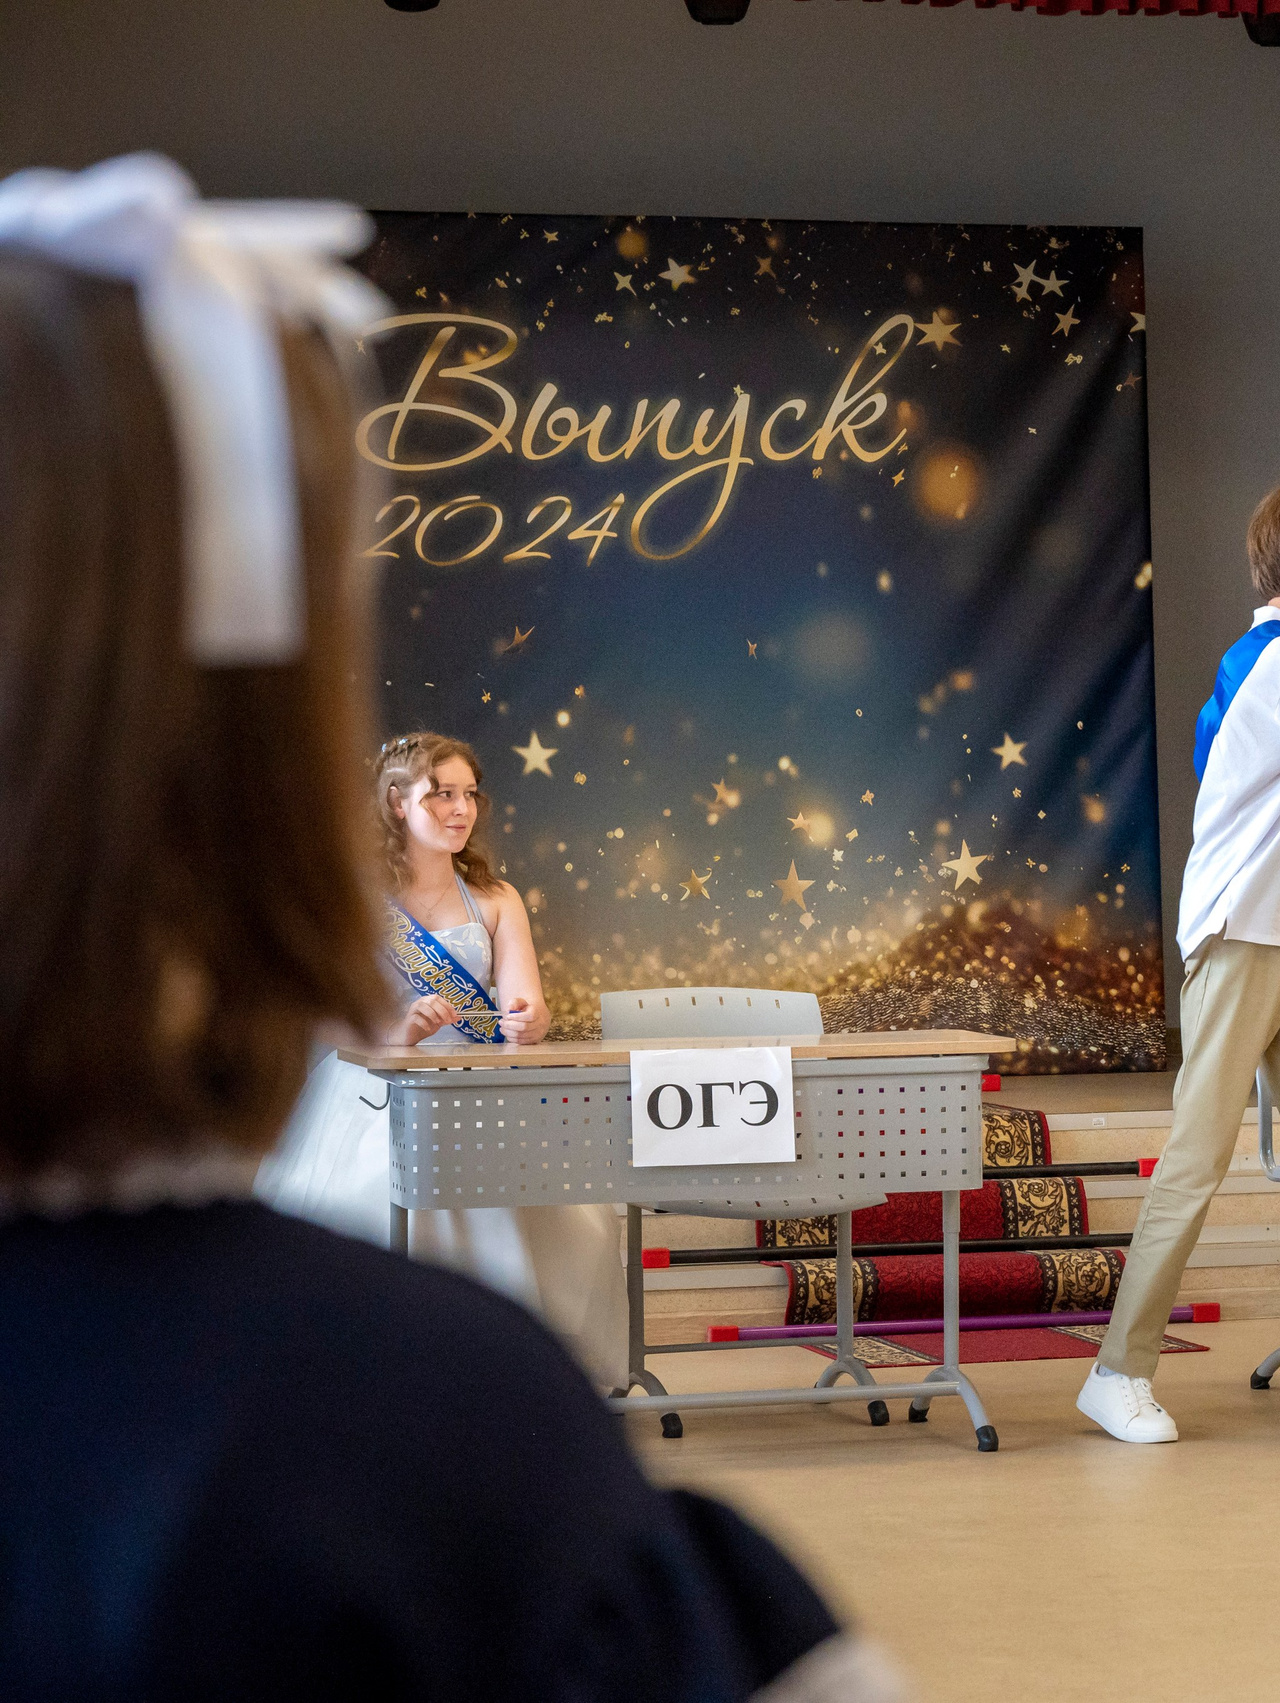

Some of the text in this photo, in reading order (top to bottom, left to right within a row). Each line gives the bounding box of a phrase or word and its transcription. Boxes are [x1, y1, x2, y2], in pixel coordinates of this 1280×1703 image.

[355, 313, 914, 560] Выпуск
[361, 493, 625, 567] 2024
[646, 1080, 779, 1130] ОГЭ
